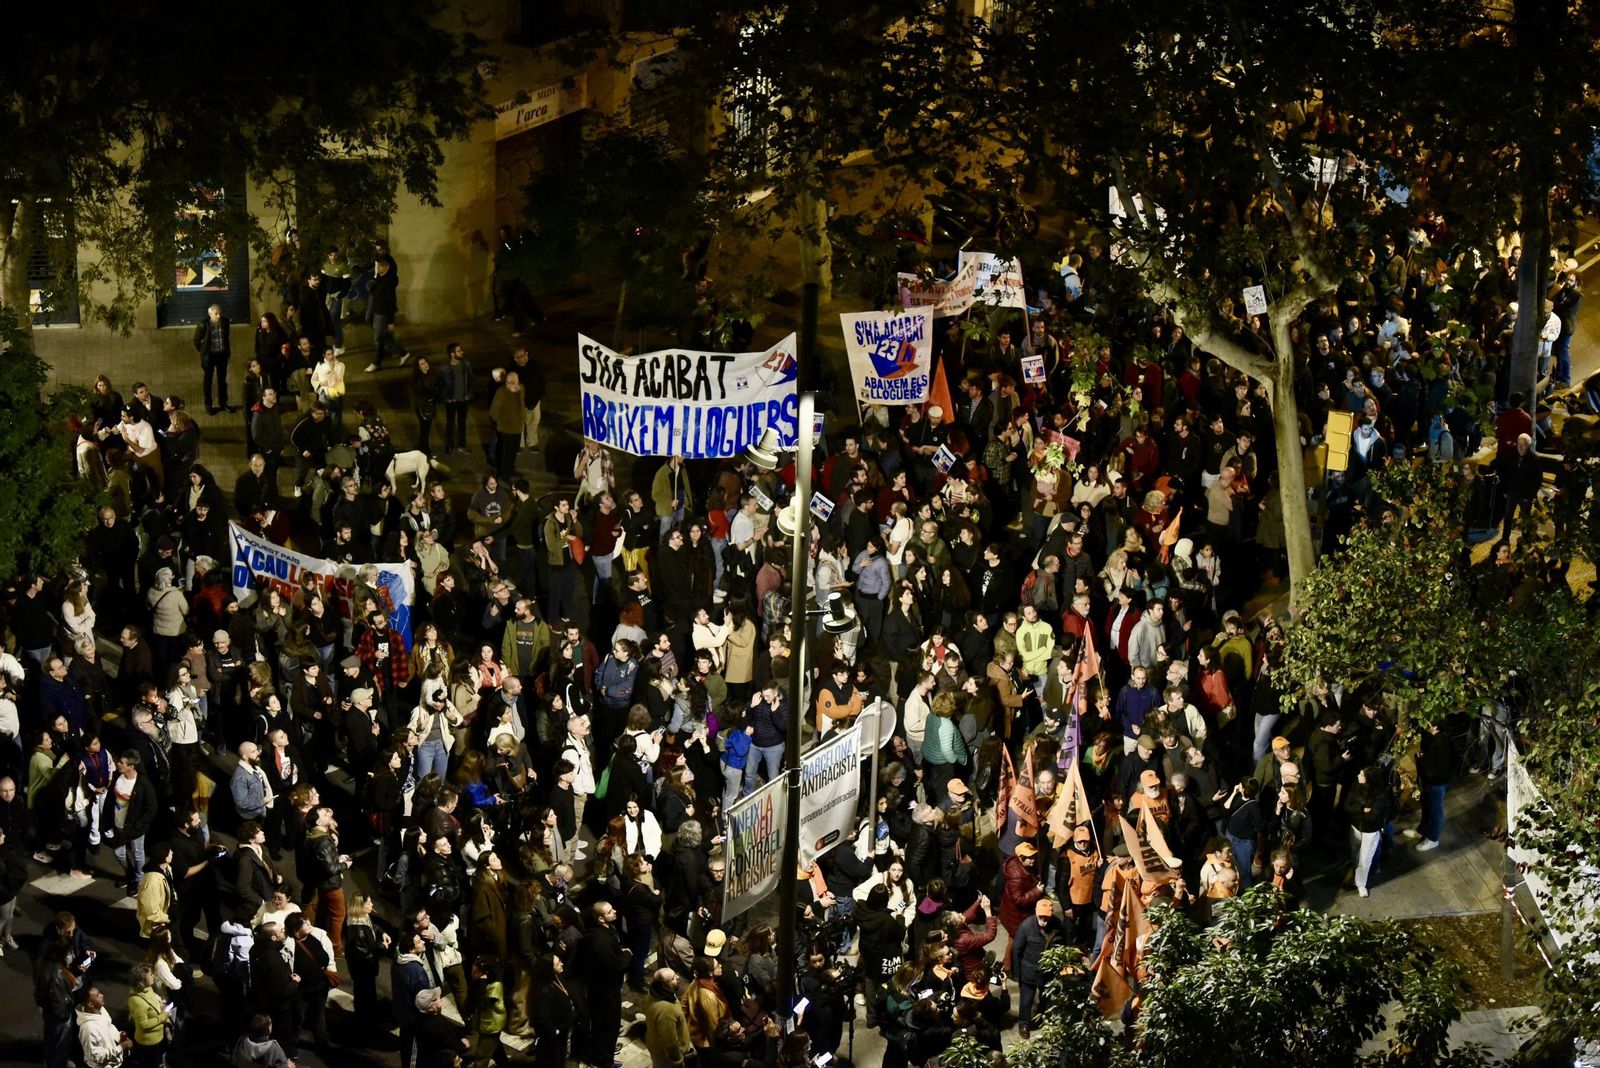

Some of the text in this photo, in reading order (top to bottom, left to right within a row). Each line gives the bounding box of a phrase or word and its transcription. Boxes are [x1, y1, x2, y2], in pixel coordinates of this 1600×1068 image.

[516, 104, 548, 125] l'arca
[883, 314, 925, 343] ACABAT
[581, 344, 736, 402] S'HA ACABAT
[864, 374, 928, 390] ABAIXEM ELS
[870, 387, 923, 400] LLOGUERS
[582, 391, 800, 459] ABAIXEM LLOGUERS
[252, 550, 288, 580] CAU
[800, 752, 857, 799] ANTIRACISTA
[801, 738, 853, 783] BARCELONA
[730, 792, 774, 838] UNEIX LA
[752, 812, 773, 844] VEU
[729, 834, 770, 881] CONTRA
[769, 827, 782, 856] EL
[727, 852, 776, 902] RACISME
[882, 956, 902, 967] ZUM
